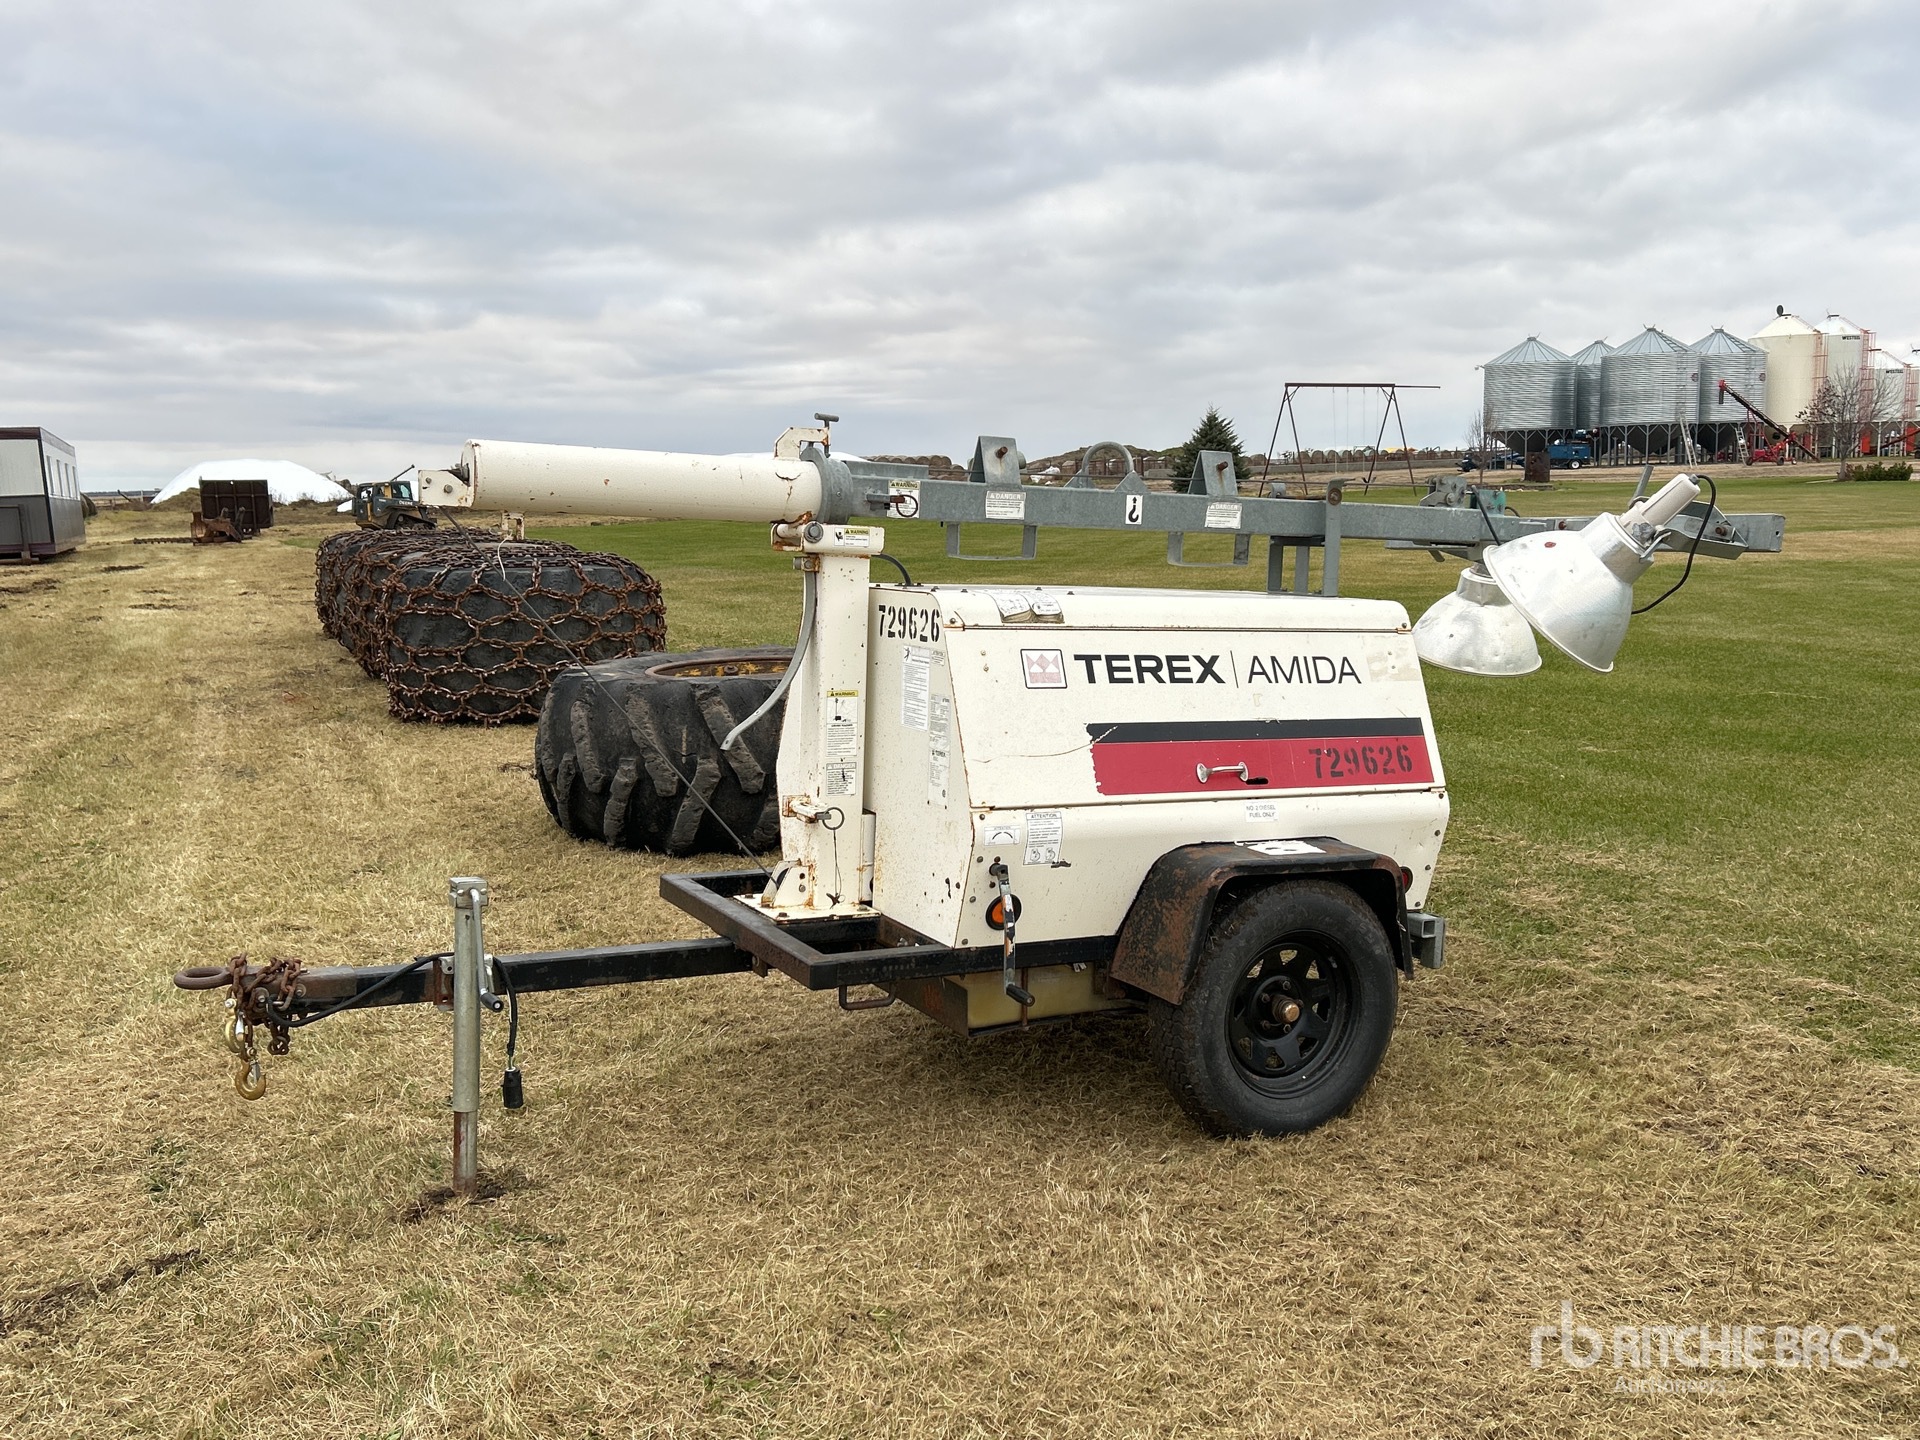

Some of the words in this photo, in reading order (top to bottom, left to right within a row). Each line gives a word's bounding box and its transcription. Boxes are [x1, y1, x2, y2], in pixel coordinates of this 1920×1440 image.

[878, 604, 940, 643] 729626
[1073, 654, 1226, 684] TEREX
[1247, 655, 1362, 684] AMIDA
[1308, 744, 1413, 779] 729626
